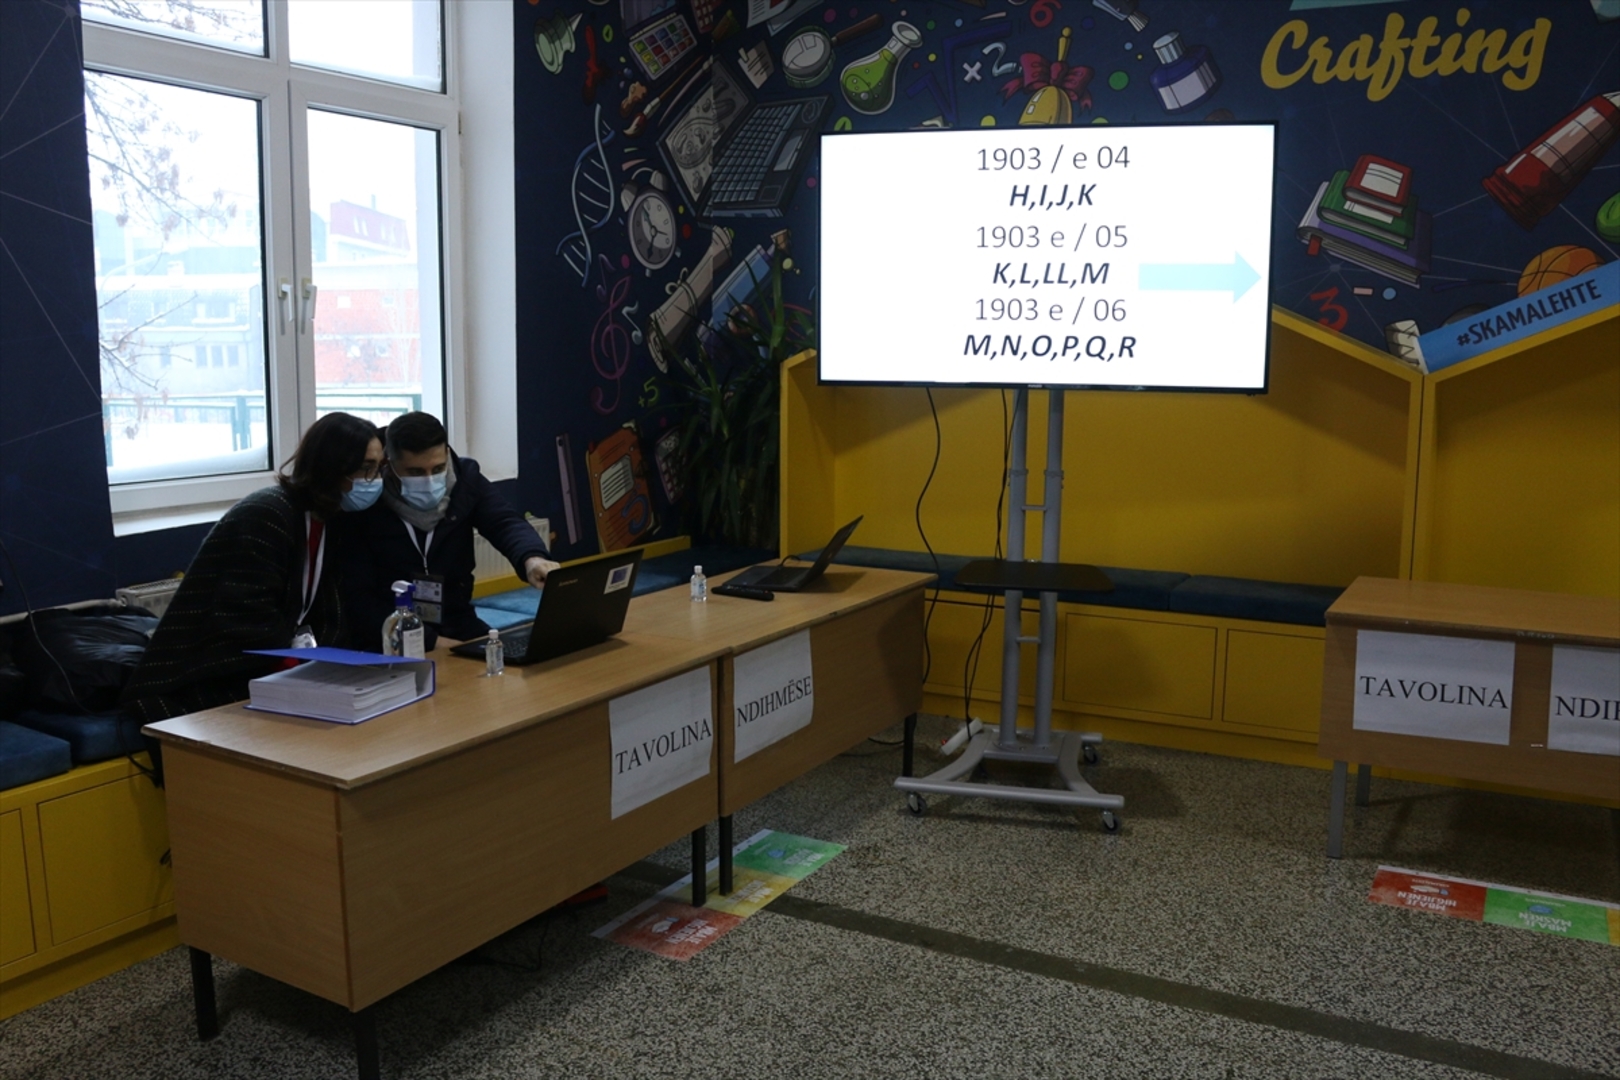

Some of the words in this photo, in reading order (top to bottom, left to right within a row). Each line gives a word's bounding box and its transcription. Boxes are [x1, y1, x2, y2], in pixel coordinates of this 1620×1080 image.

[1260, 8, 1552, 102] Crafting
[977, 147, 1042, 171] 1903
[1050, 144, 1064, 174] /
[1072, 151, 1088, 170] e
[1096, 145, 1131, 170] 04
[1009, 183, 1097, 212] H,I,J,K
[976, 225, 1041, 249] 1903
[1050, 230, 1065, 249] e
[1073, 222, 1088, 253] /
[1095, 224, 1129, 249] 05
[992, 262, 1111, 290] K,L,LL,M
[975, 297, 1039, 321] 1903
[1048, 303, 1064, 321] e
[1071, 296, 1086, 325] /
[1093, 298, 1127, 322] 06
[1456, 278, 1602, 348] #SKAMALEHTE
[963, 334, 1137, 363] M,N,O,P,Q,R
[736, 675, 813, 728] NDIHMËSE
[1359, 675, 1510, 710] TAVOLINA
[615, 717, 713, 776] TAVOLINA
